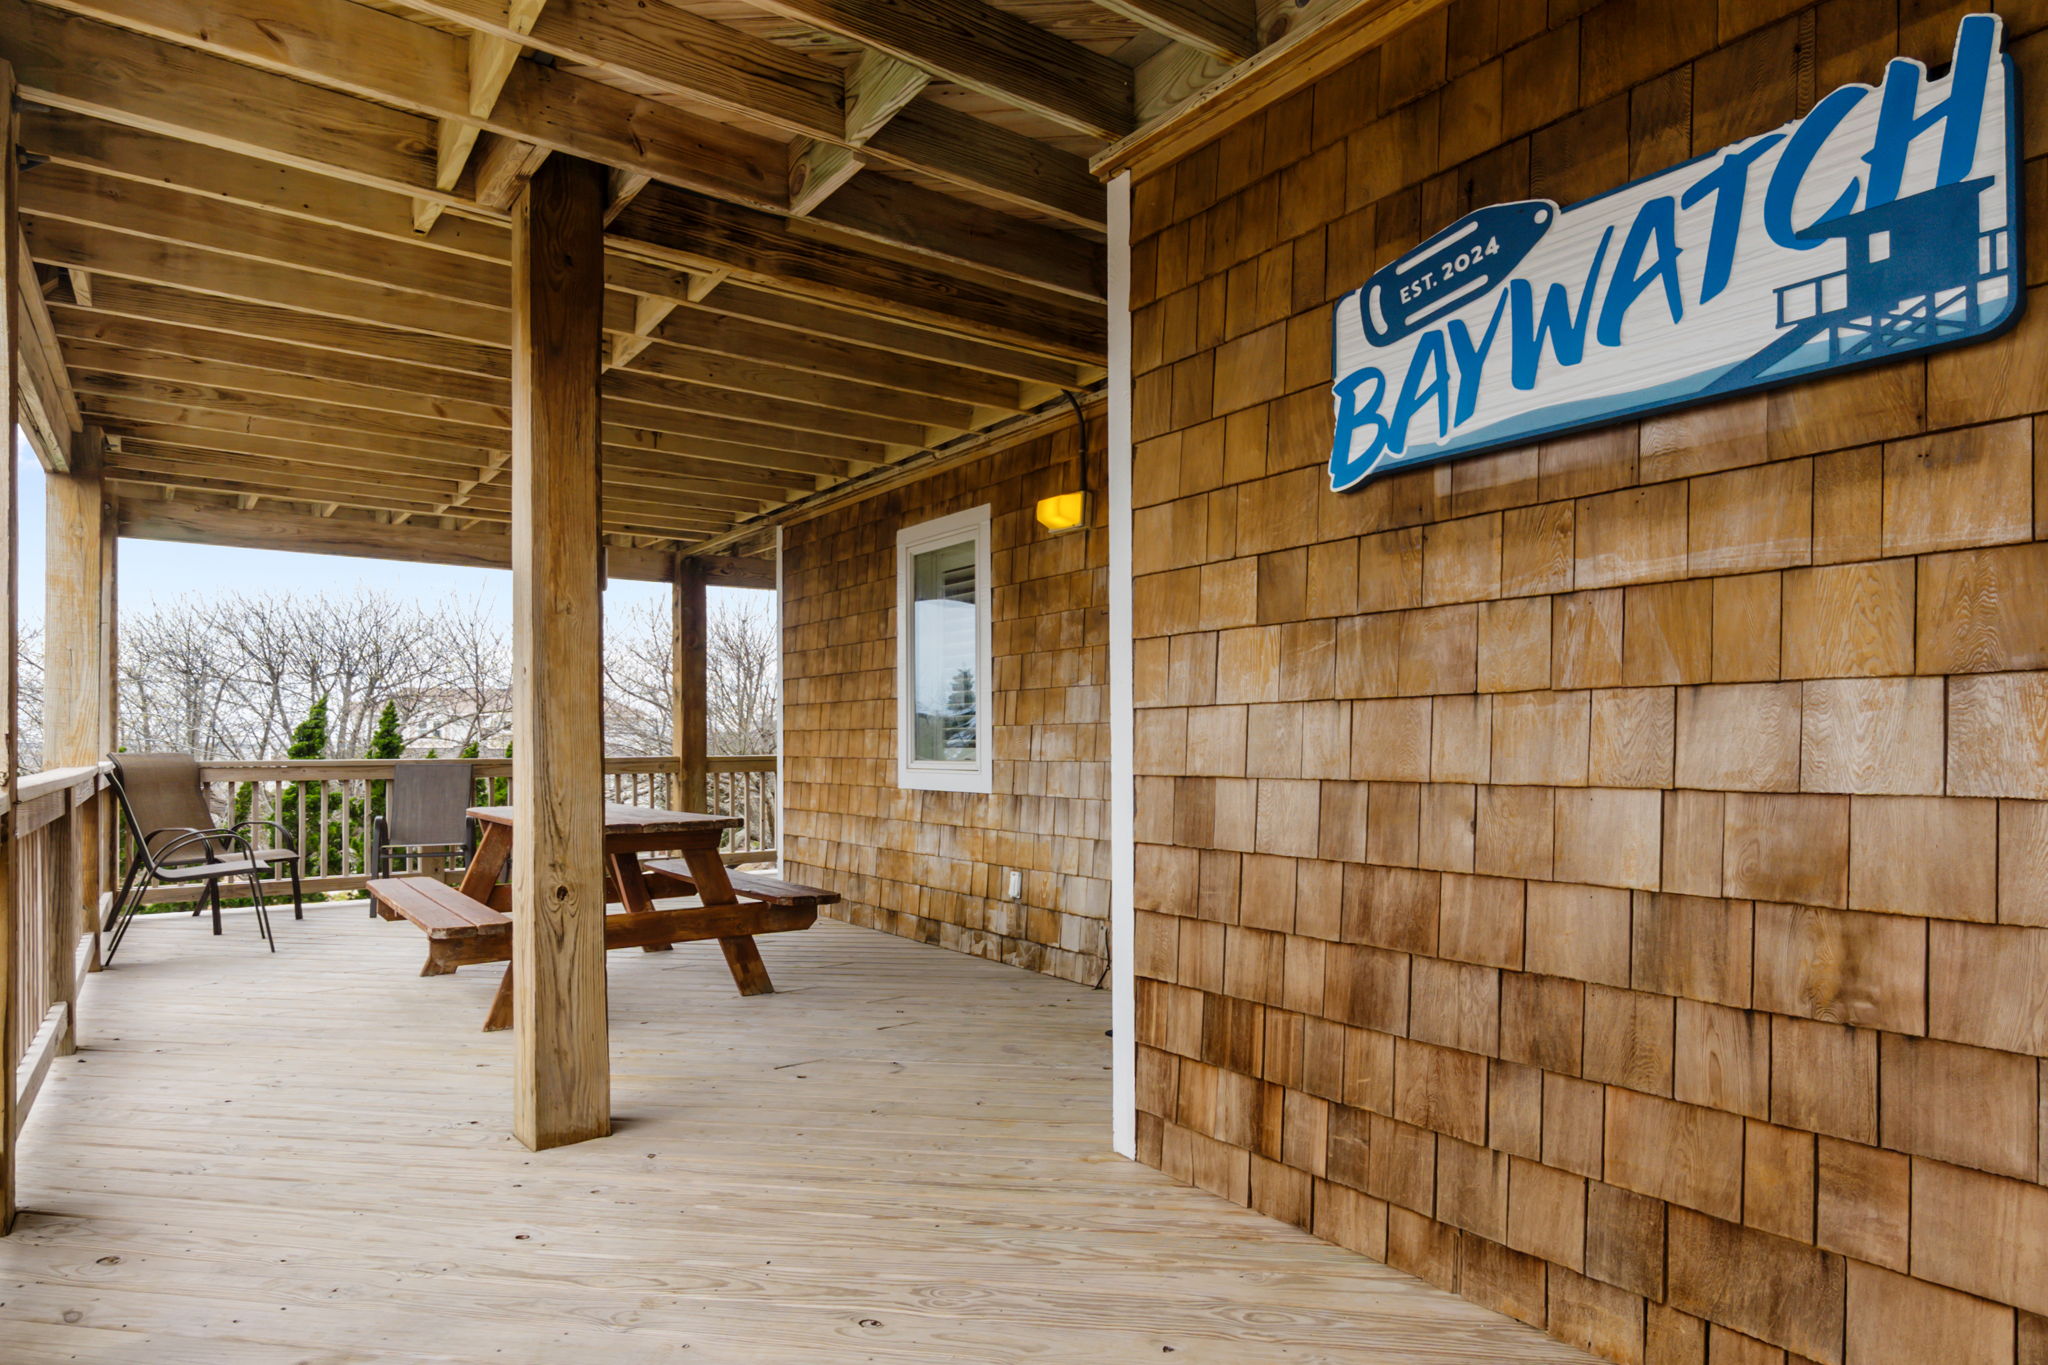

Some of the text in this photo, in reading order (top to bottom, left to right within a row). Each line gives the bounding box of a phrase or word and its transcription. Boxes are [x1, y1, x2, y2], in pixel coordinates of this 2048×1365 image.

[1330, 15, 1997, 490] BAYWATCH
[1400, 235, 1500, 304] EST. 2024
